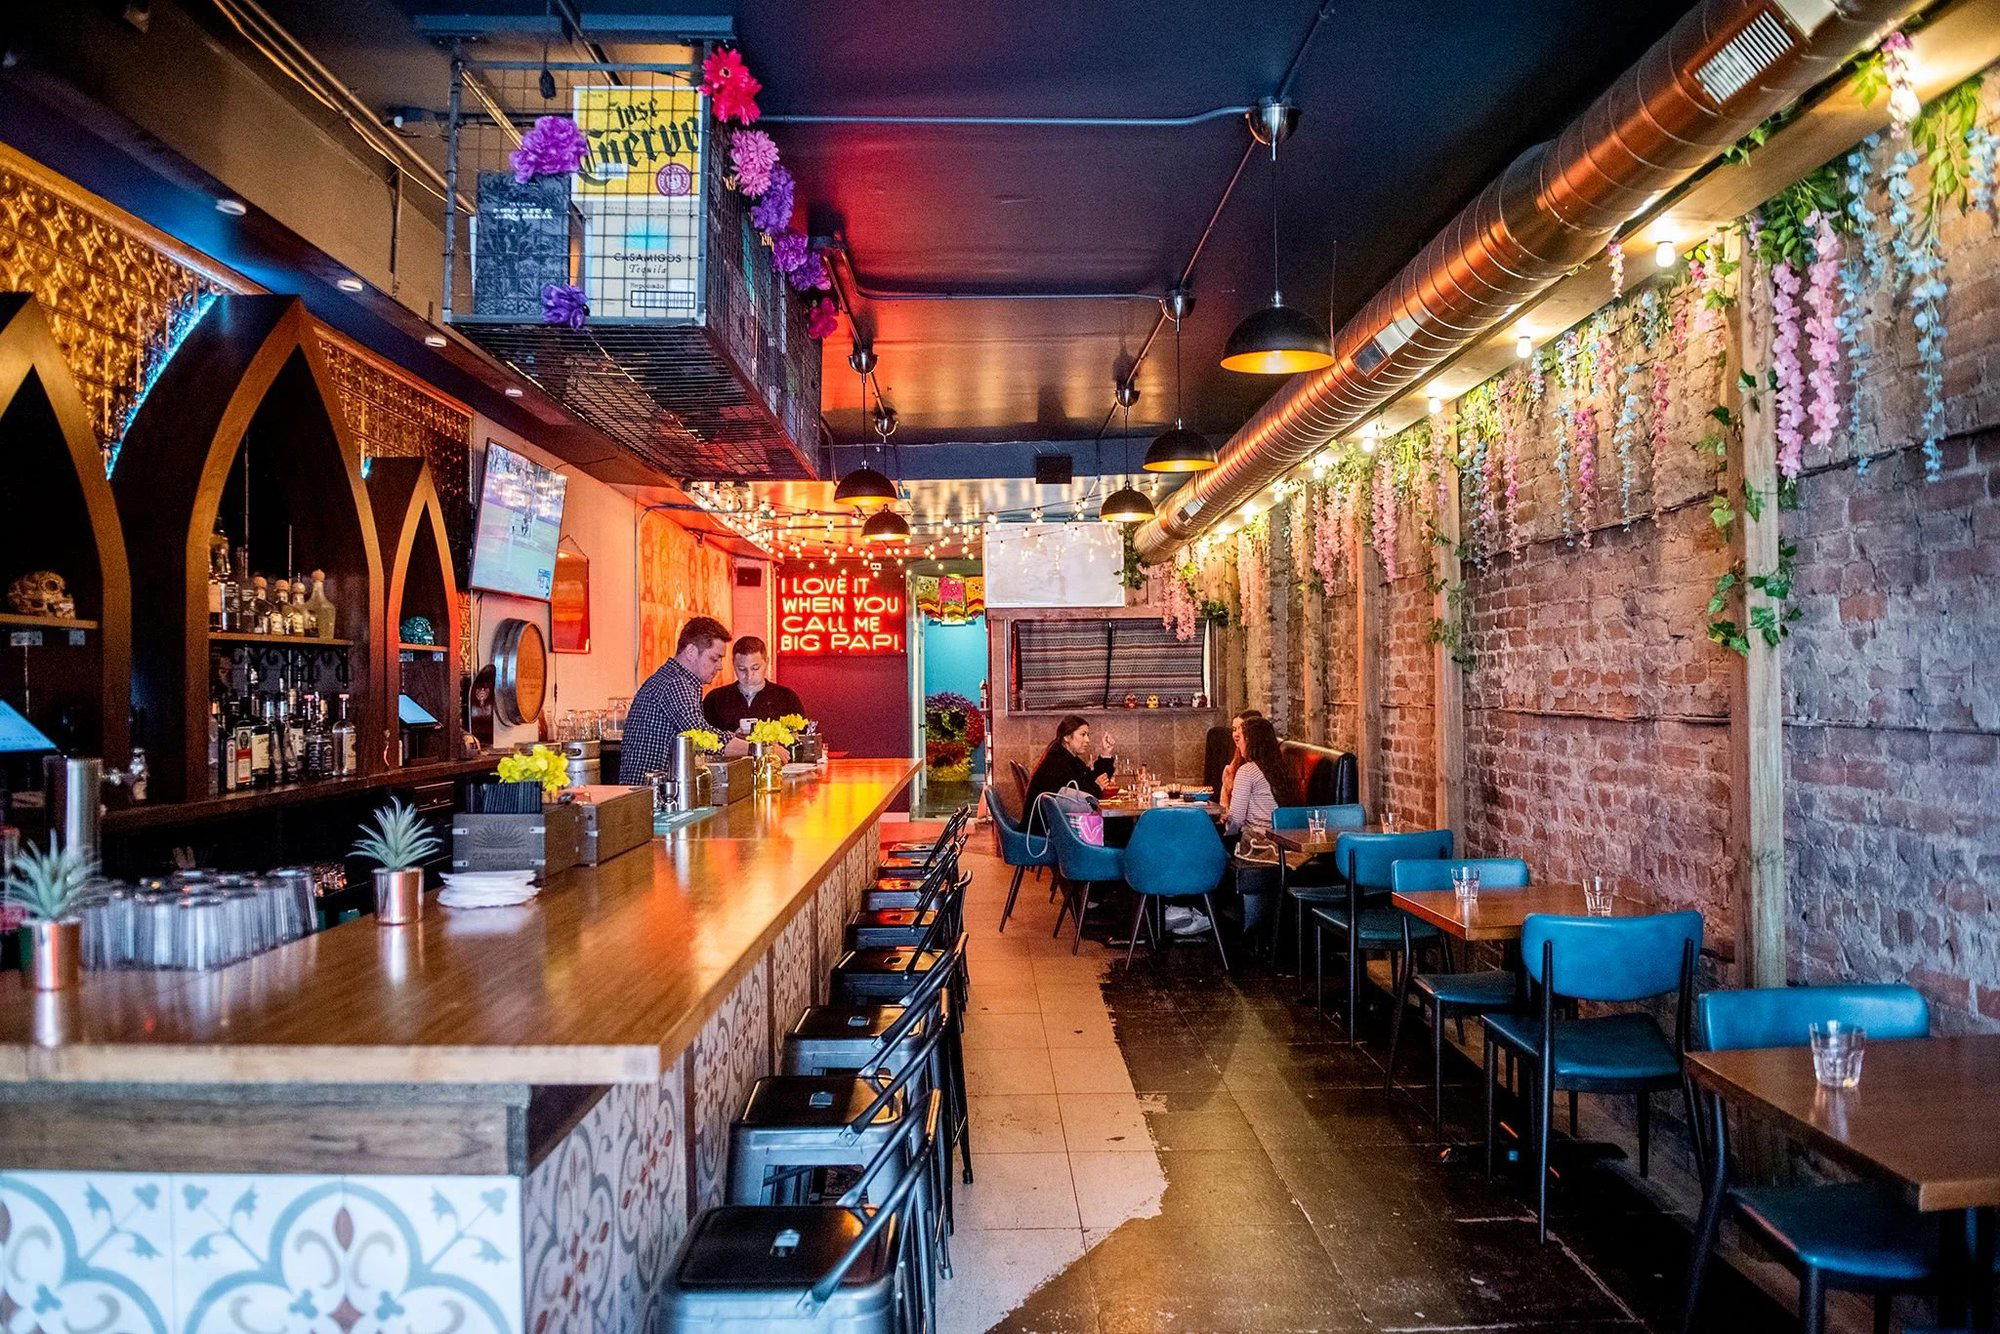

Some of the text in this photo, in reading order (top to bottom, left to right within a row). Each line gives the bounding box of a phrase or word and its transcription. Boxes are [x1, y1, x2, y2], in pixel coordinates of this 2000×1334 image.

[613, 252, 682, 263] CASAMIGOS
[628, 264, 667, 277] Tequila
[780, 577, 870, 595] I LOVE IT
[782, 596, 899, 614] WHEN YOU
[781, 615, 880, 632] CALL ME
[780, 633, 899, 651] BIG PAPI
